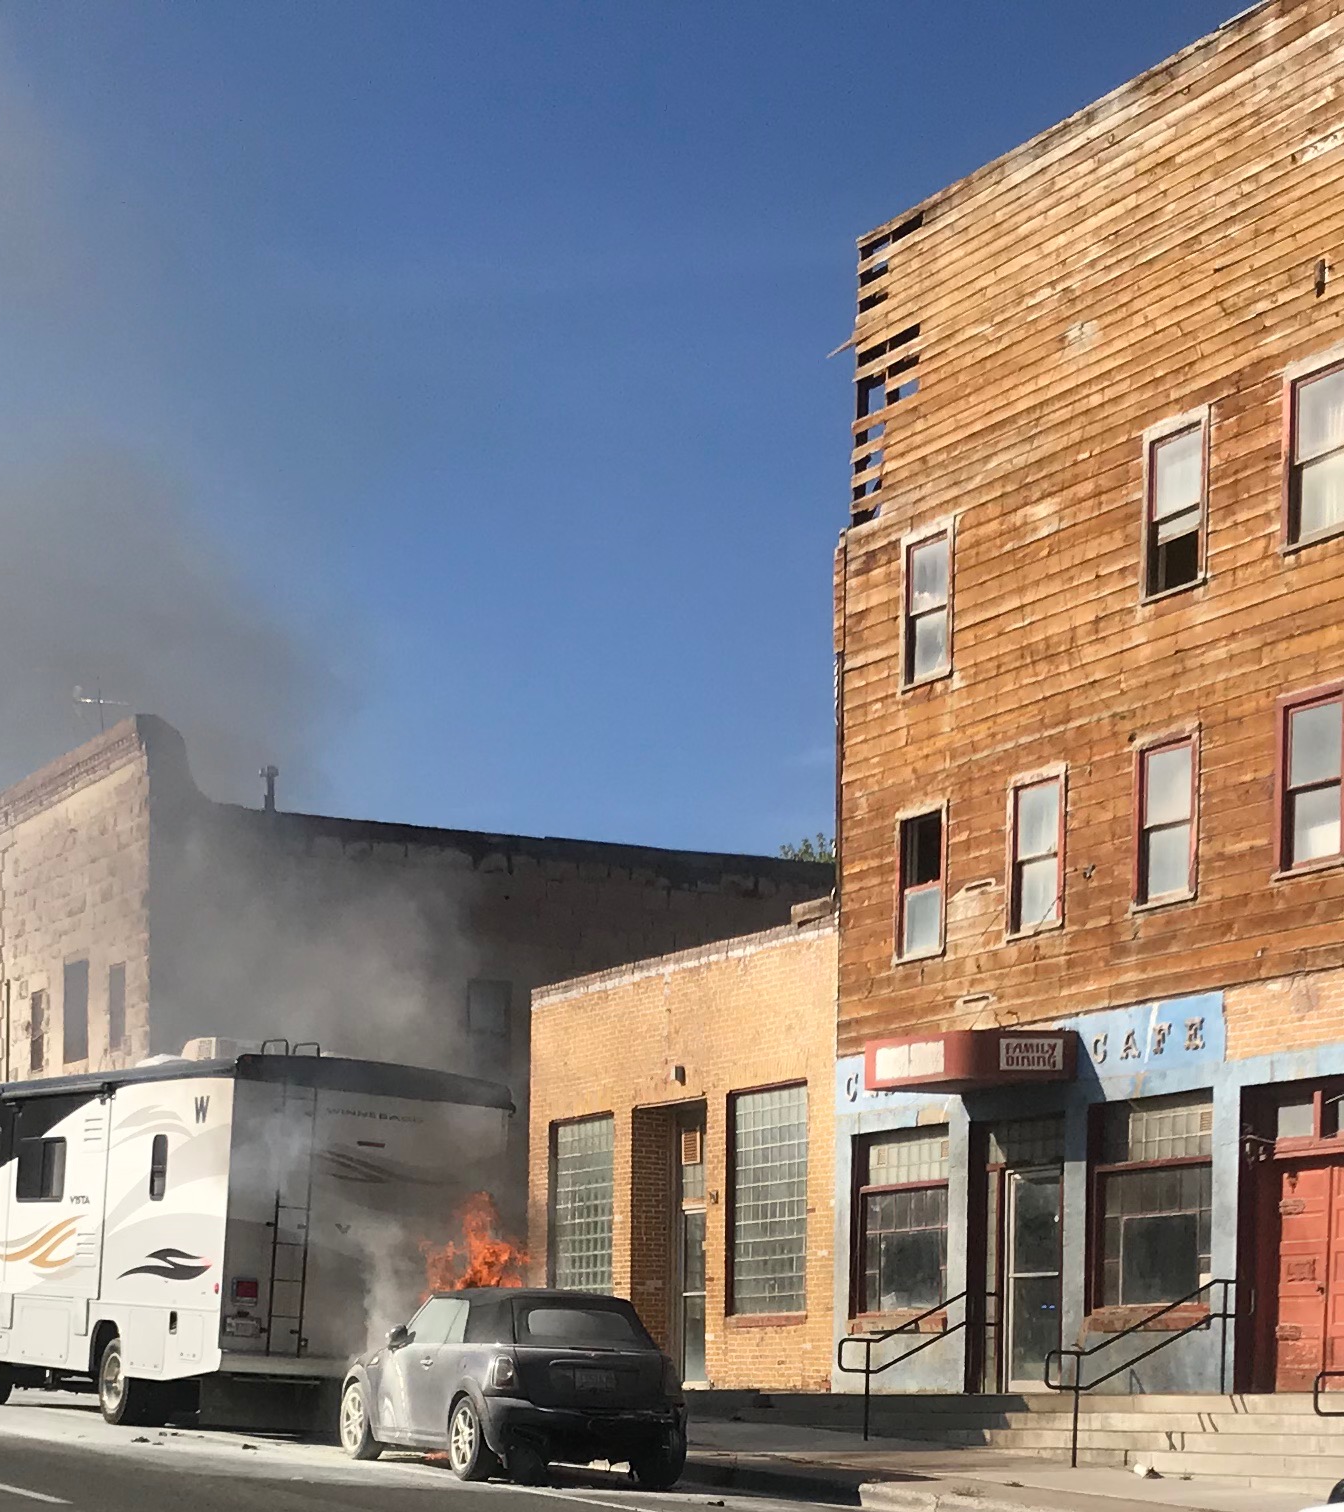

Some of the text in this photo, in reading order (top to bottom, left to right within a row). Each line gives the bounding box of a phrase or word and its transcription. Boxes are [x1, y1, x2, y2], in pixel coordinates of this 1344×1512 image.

[1005, 1042, 1058, 1056] FAMILY
[1093, 1016, 1207, 1065] CAFE
[1006, 1055, 1057, 1069] DINING
[194, 1095, 211, 1124] W
